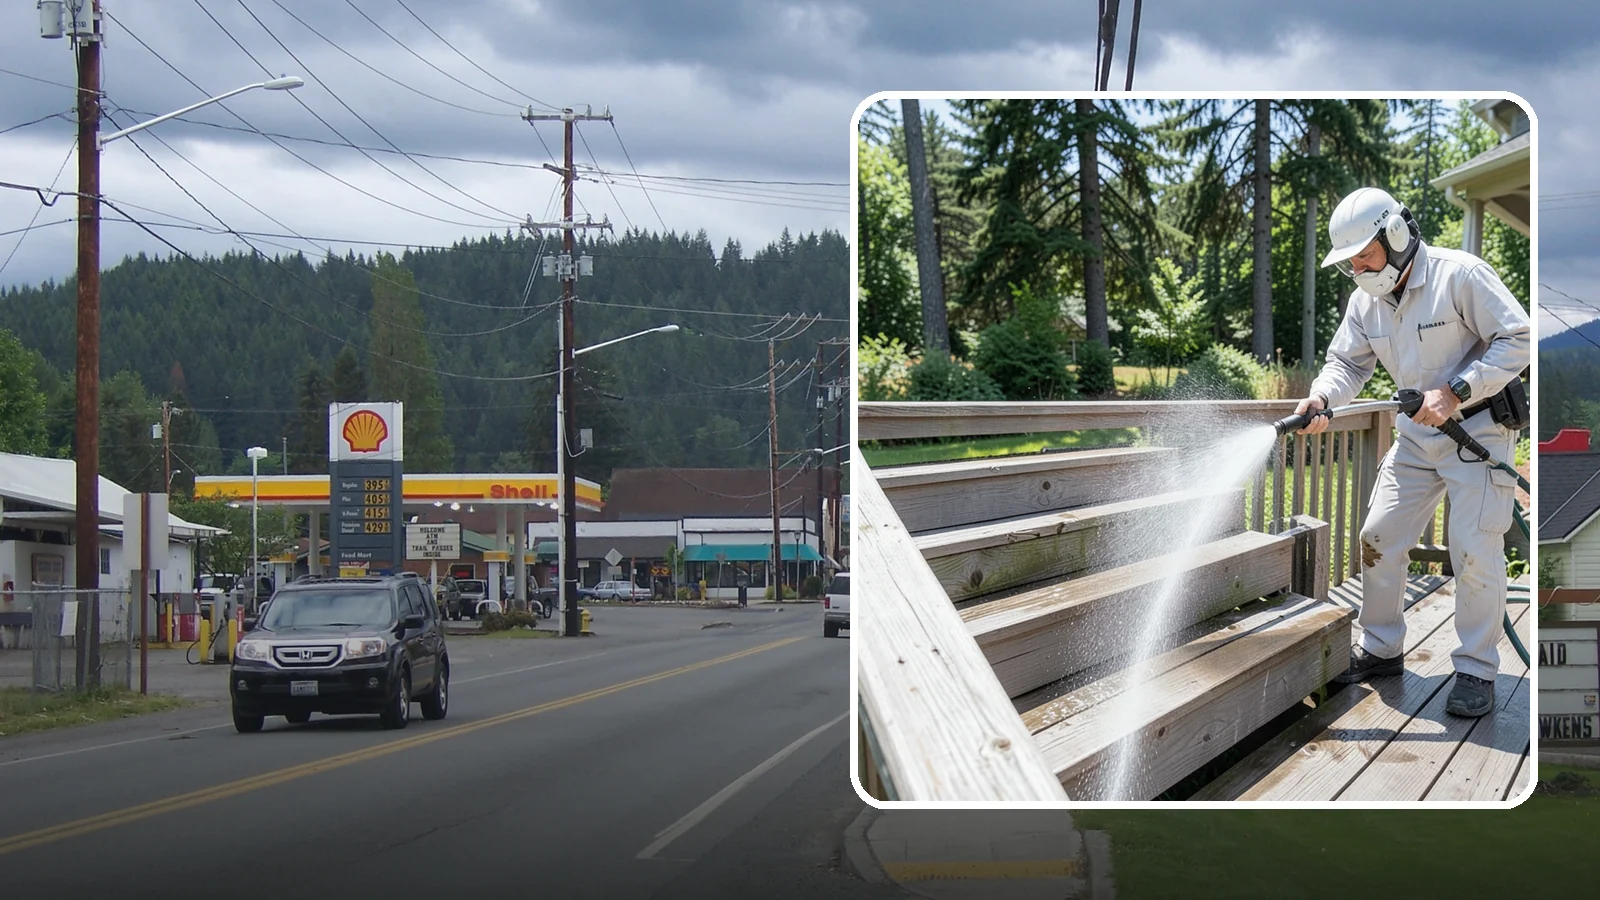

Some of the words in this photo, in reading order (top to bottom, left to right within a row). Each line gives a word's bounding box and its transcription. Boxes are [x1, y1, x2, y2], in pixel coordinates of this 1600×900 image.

[366, 480, 383, 490] 395
[490, 484, 547, 499] Shell
[366, 494, 383, 504] 405
[366, 508, 383, 518] 415
[366, 522, 383, 533] 429
[1539, 643, 1567, 665] AID
